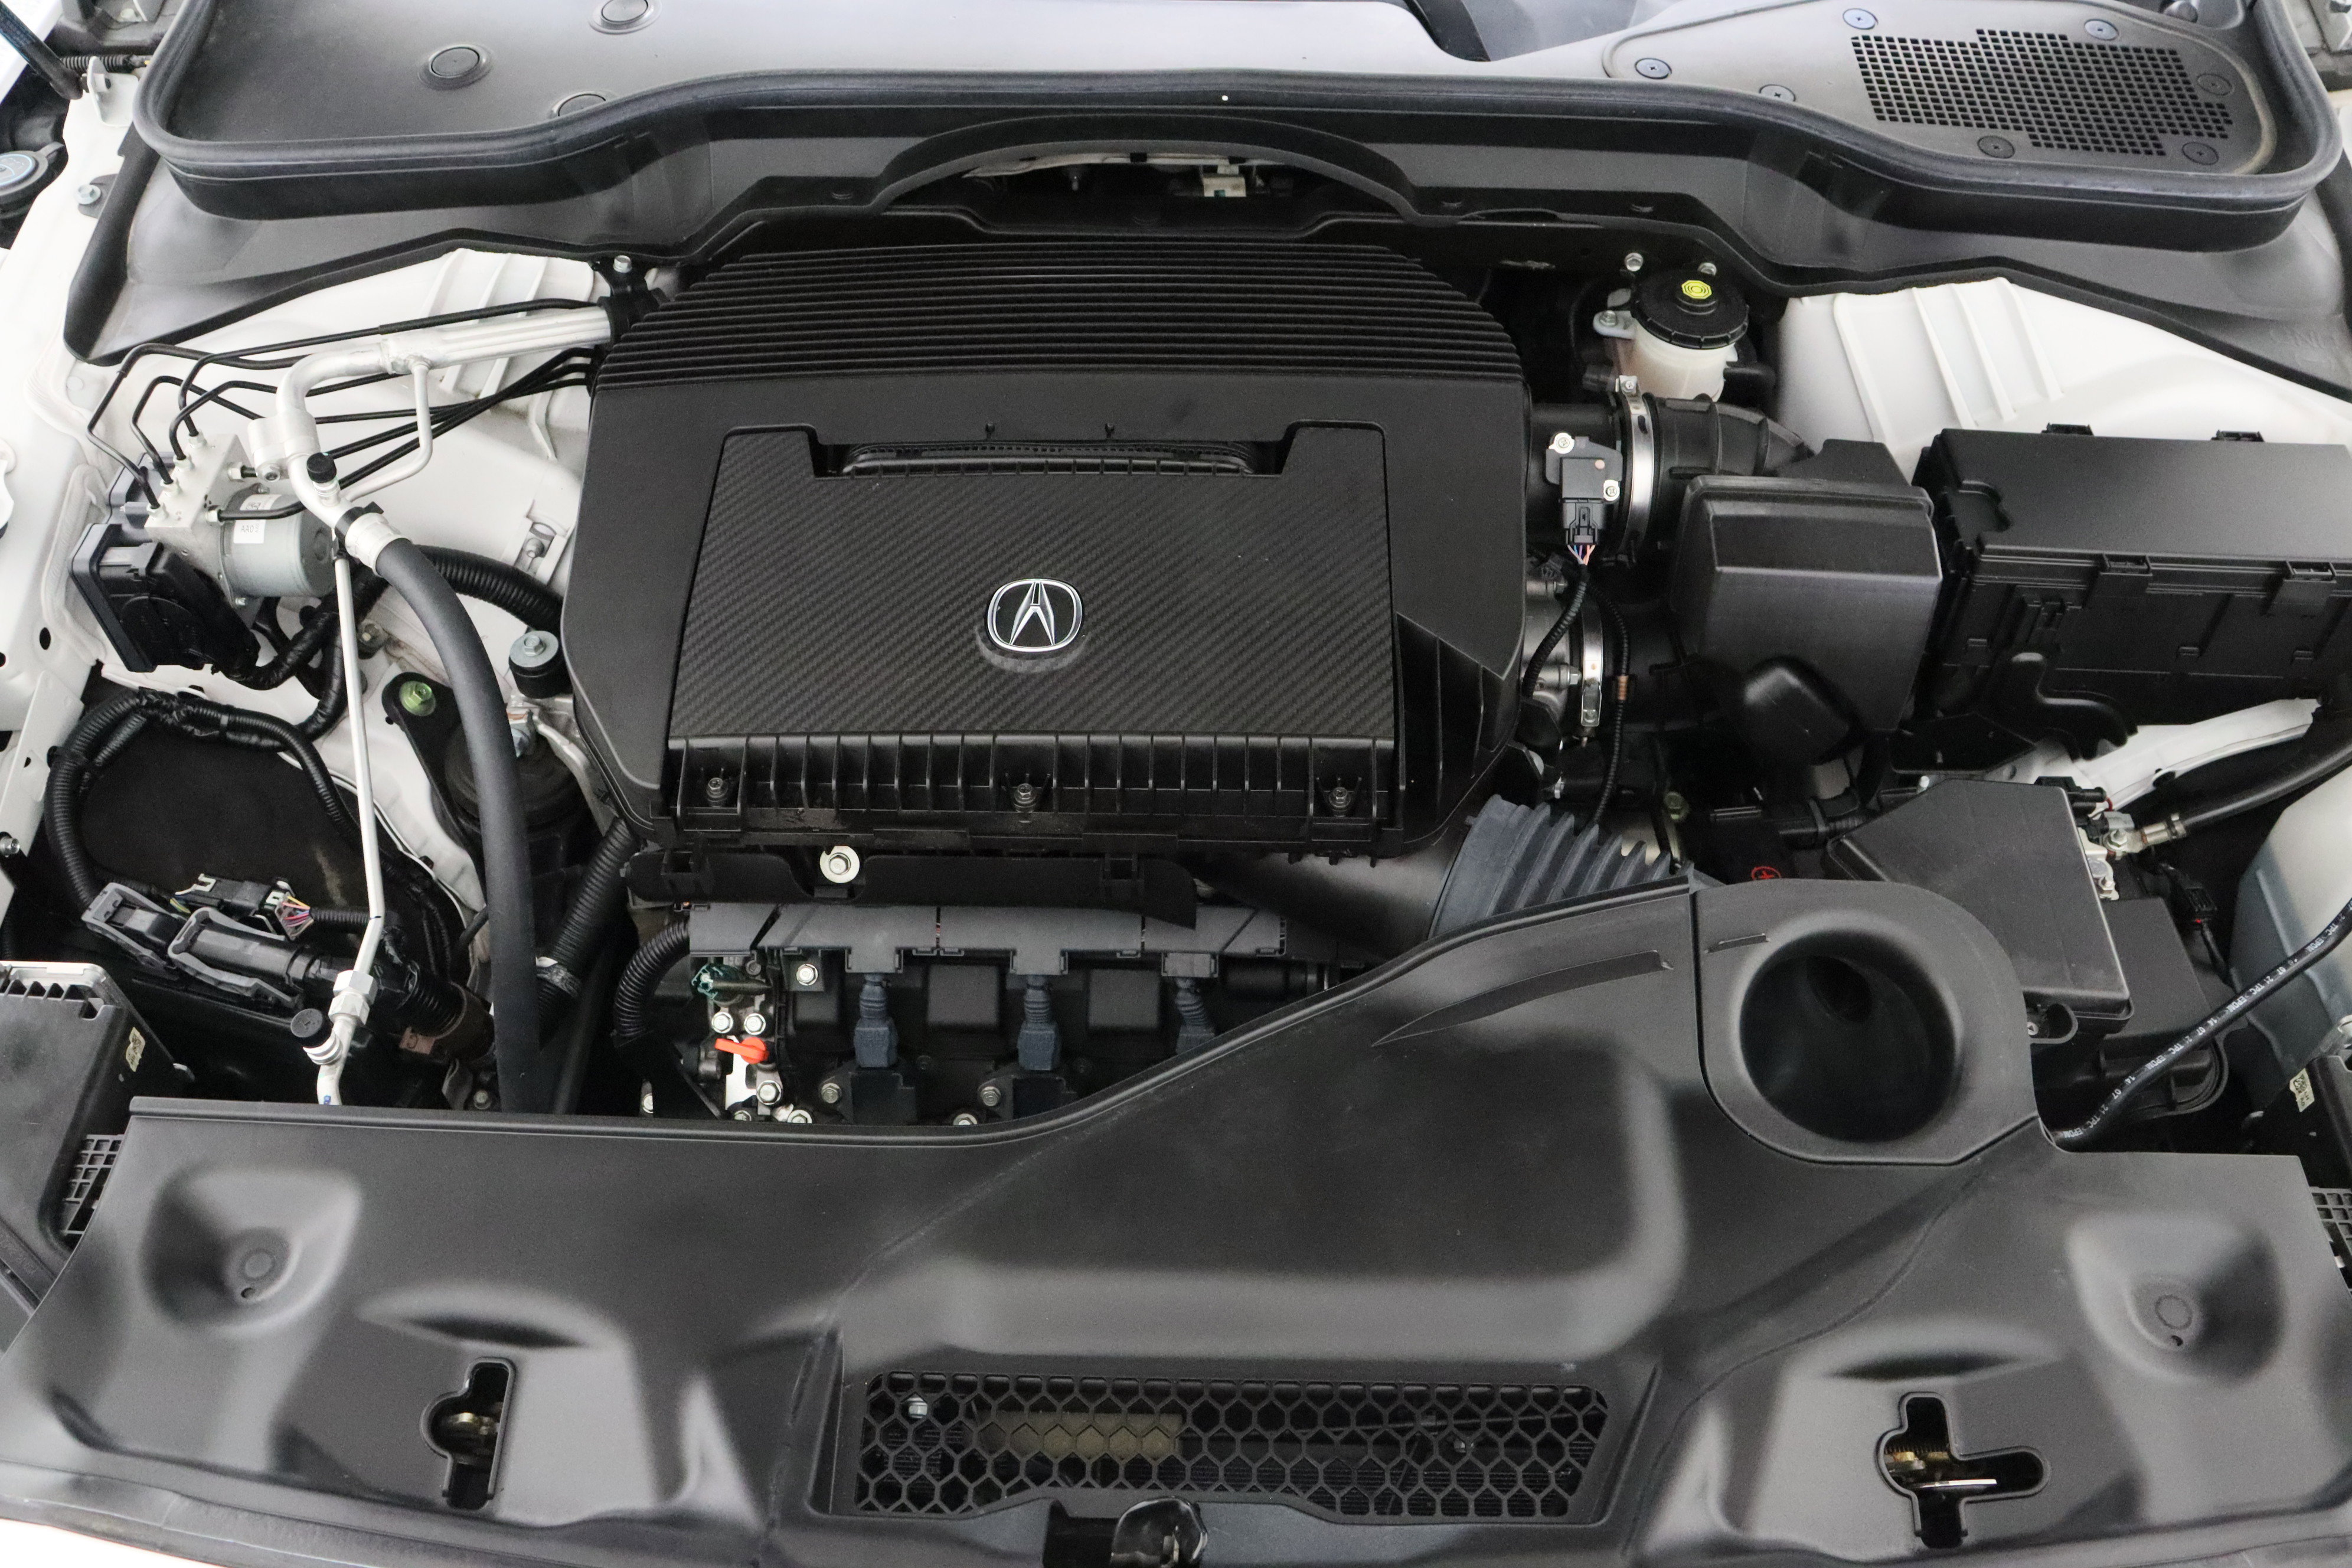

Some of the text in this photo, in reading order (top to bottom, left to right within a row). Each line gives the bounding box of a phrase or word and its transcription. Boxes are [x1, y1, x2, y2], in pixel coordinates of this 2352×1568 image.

[2249, 983, 2265, 995] TPC
[2168, 1043, 2184, 1054] TPC
[2125, 1076, 2136, 1084] 14
[2112, 1089, 2122, 1099] 07
[2100, 1104, 2109, 1115] 21
[2089, 1115, 2101, 1128] TPC
